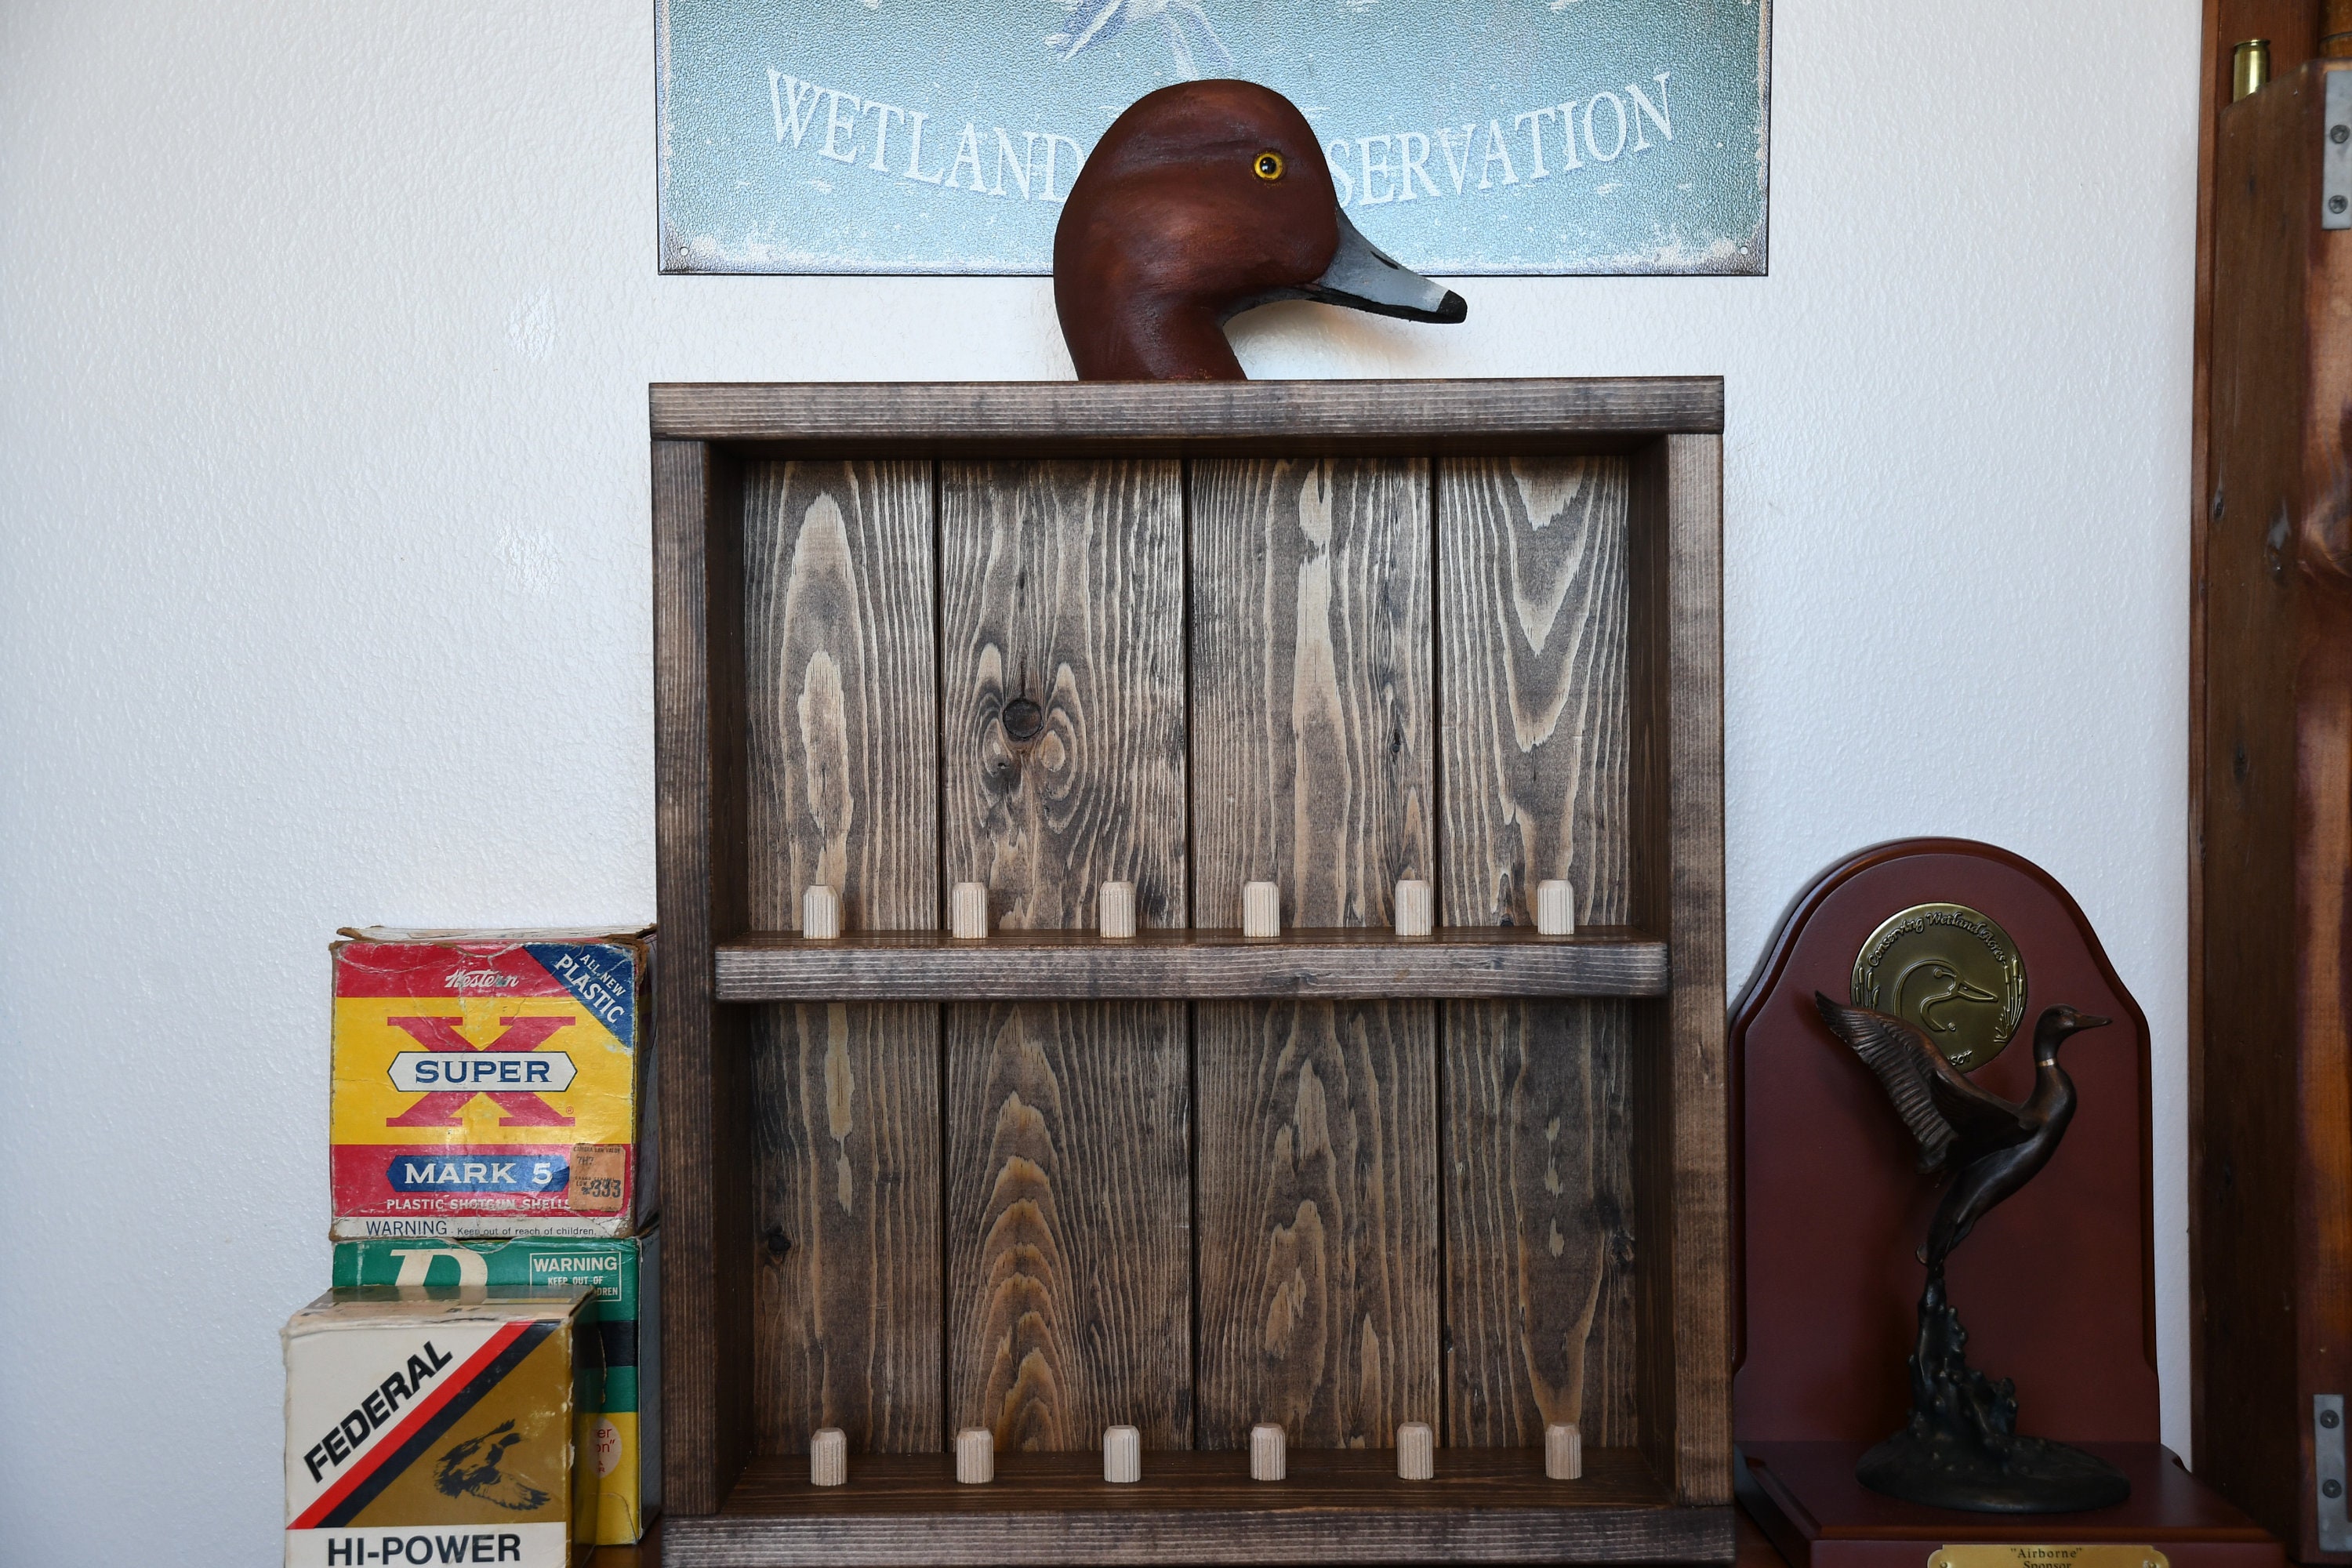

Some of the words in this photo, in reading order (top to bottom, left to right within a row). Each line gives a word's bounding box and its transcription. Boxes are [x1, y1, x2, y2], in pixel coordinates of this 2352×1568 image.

[1324, 71, 1674, 209] SERVATION
[1867, 918, 1925, 967] Conserving
[1926, 912, 1987, 934] Wetland
[1977, 928, 2006, 962] Acres
[445, 969, 519, 988] Western
[554, 953, 625, 1024] PLASTIC
[600, 972, 626, 996] NEW
[415, 1060, 552, 1083] SUPER
[404, 1163, 517, 1184] MARK
[531, 1162, 554, 1184] 5
[387, 1199, 444, 1210] PLASTIC
[449, 1199, 516, 1210] SHOTGUN
[521, 1199, 572, 1210] SHELLS
[365, 1220, 448, 1236] WARNING
[457, 1227, 481, 1236] Keep
[502, 1227, 511, 1236] of
[515, 1227, 540, 1236] reach
[543, 1227, 554, 1236] of
[555, 1226, 597, 1236] children.
[533, 1256, 618, 1272] WARNING
[547, 1276, 568, 1287] KEEP
[572, 1276, 589, 1285] OUT
[593, 1276, 604, 1285] OF
[597, 1287, 619, 1296] DREN
[303, 1341, 453, 1483] FEDERAL
[328, 1534, 521, 1566] HI-POWER
[2010, 1547, 2082, 1559] "Airborne"
